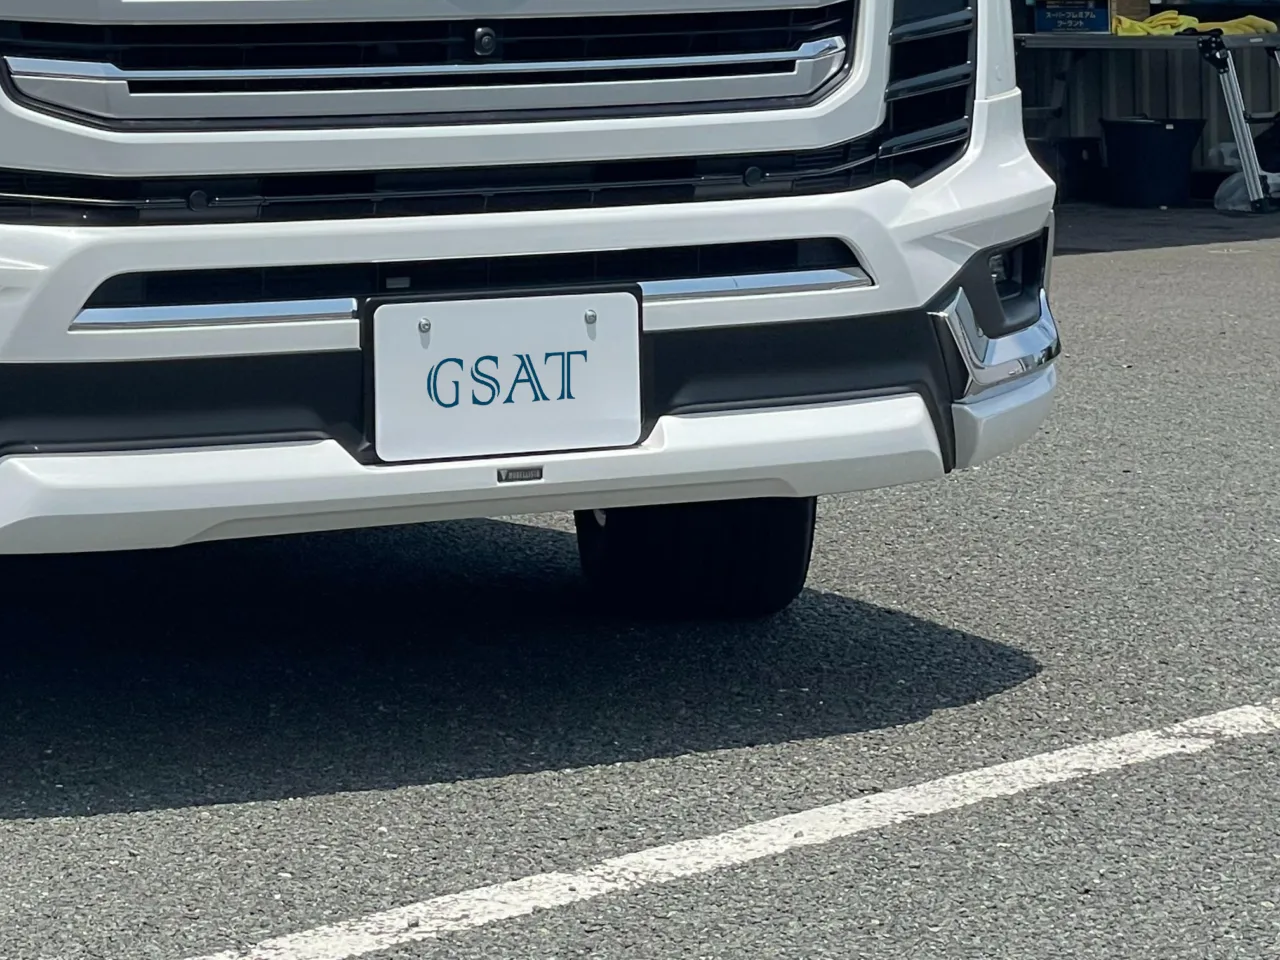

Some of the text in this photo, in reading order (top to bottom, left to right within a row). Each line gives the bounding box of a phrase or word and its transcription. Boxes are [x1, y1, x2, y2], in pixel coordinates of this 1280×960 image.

[1045, 11, 1096, 19] スーパープレミアム
[426, 350, 588, 408] GSAT
